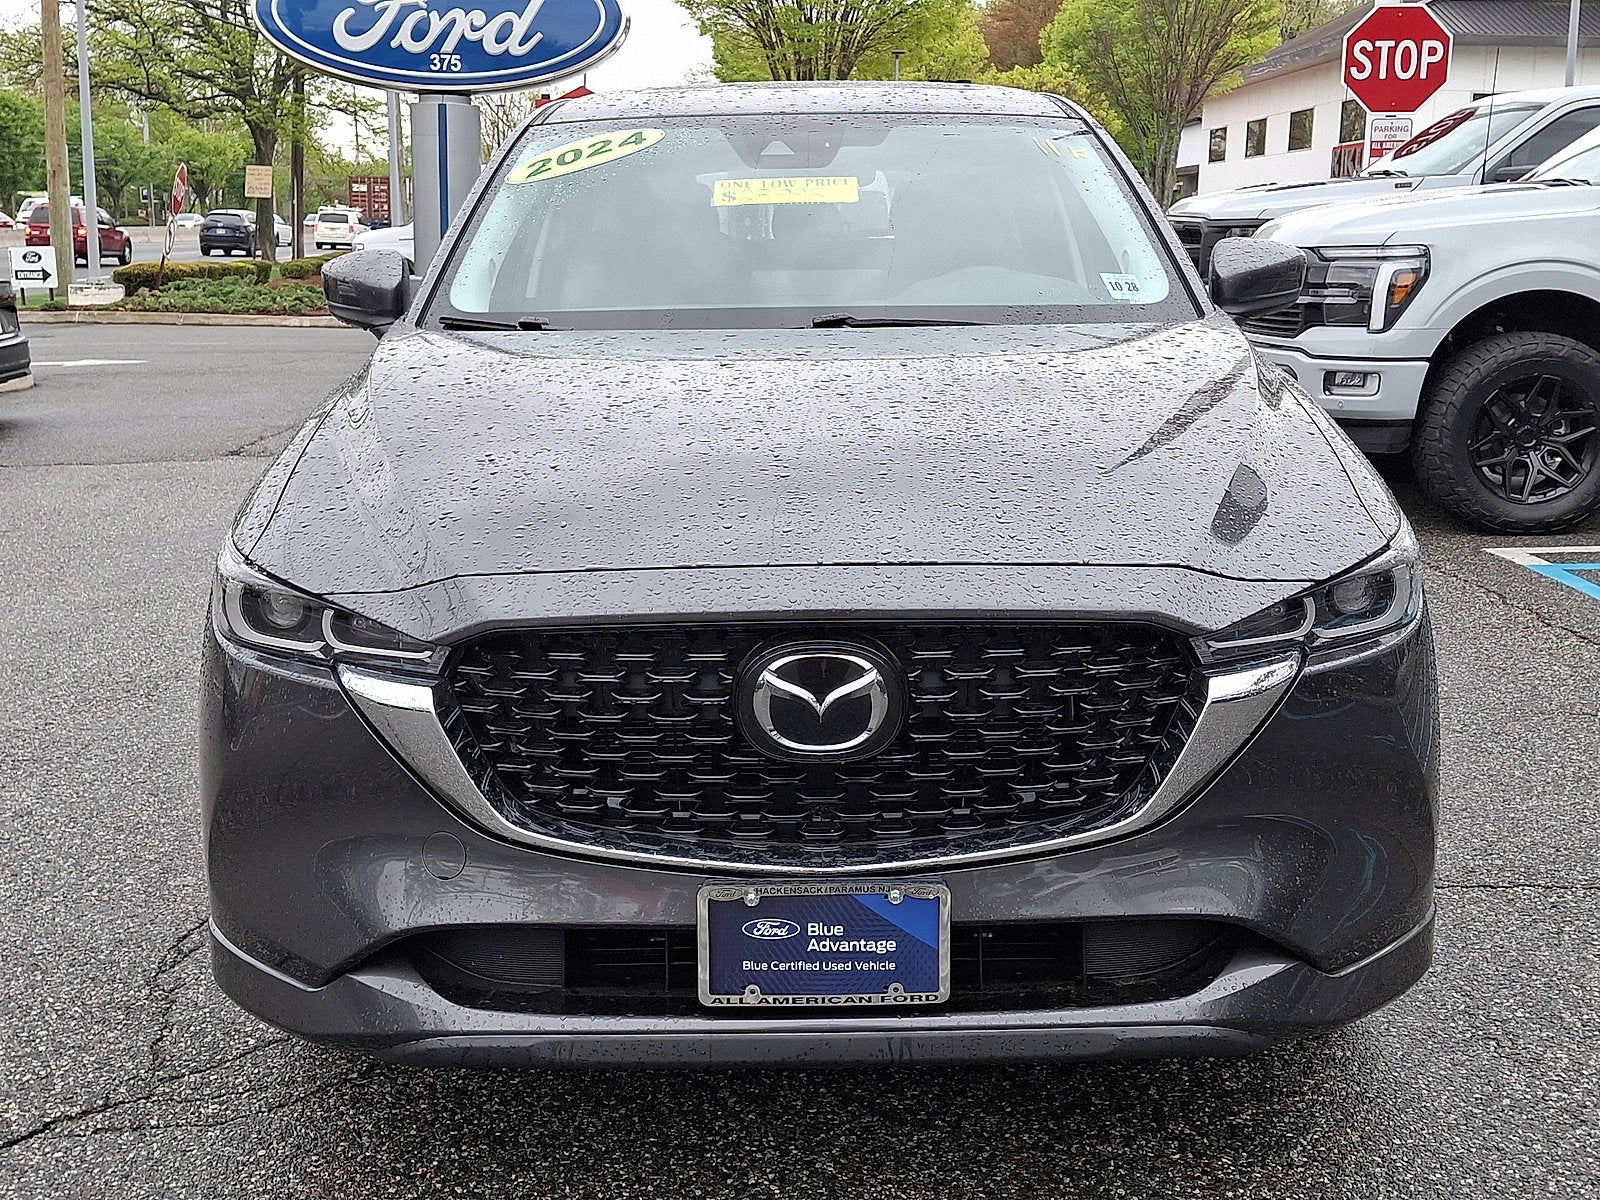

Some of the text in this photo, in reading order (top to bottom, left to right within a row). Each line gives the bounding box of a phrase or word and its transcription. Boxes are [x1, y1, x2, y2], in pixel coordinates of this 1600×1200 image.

[332, 0, 544, 56] Ford
[429, 53, 462, 72] 375
[1349, 39, 1445, 80] STOP
[1374, 125, 1409, 133] PARKING
[525, 131, 647, 179] 2024
[720, 180, 753, 189] ONE
[17, 271, 44, 279] ENTRANCE
[1108, 281, 1140, 292] 10 28
[878, 885, 891, 893] NJ
[752, 921, 790, 936] Ford
[807, 922, 844, 936] Blue
[807, 938, 897, 954] Advantage
[742, 960, 896, 971] Blue Certified Used Vehicle
[710, 994, 939, 1005] ALL AMERICAN FORD
